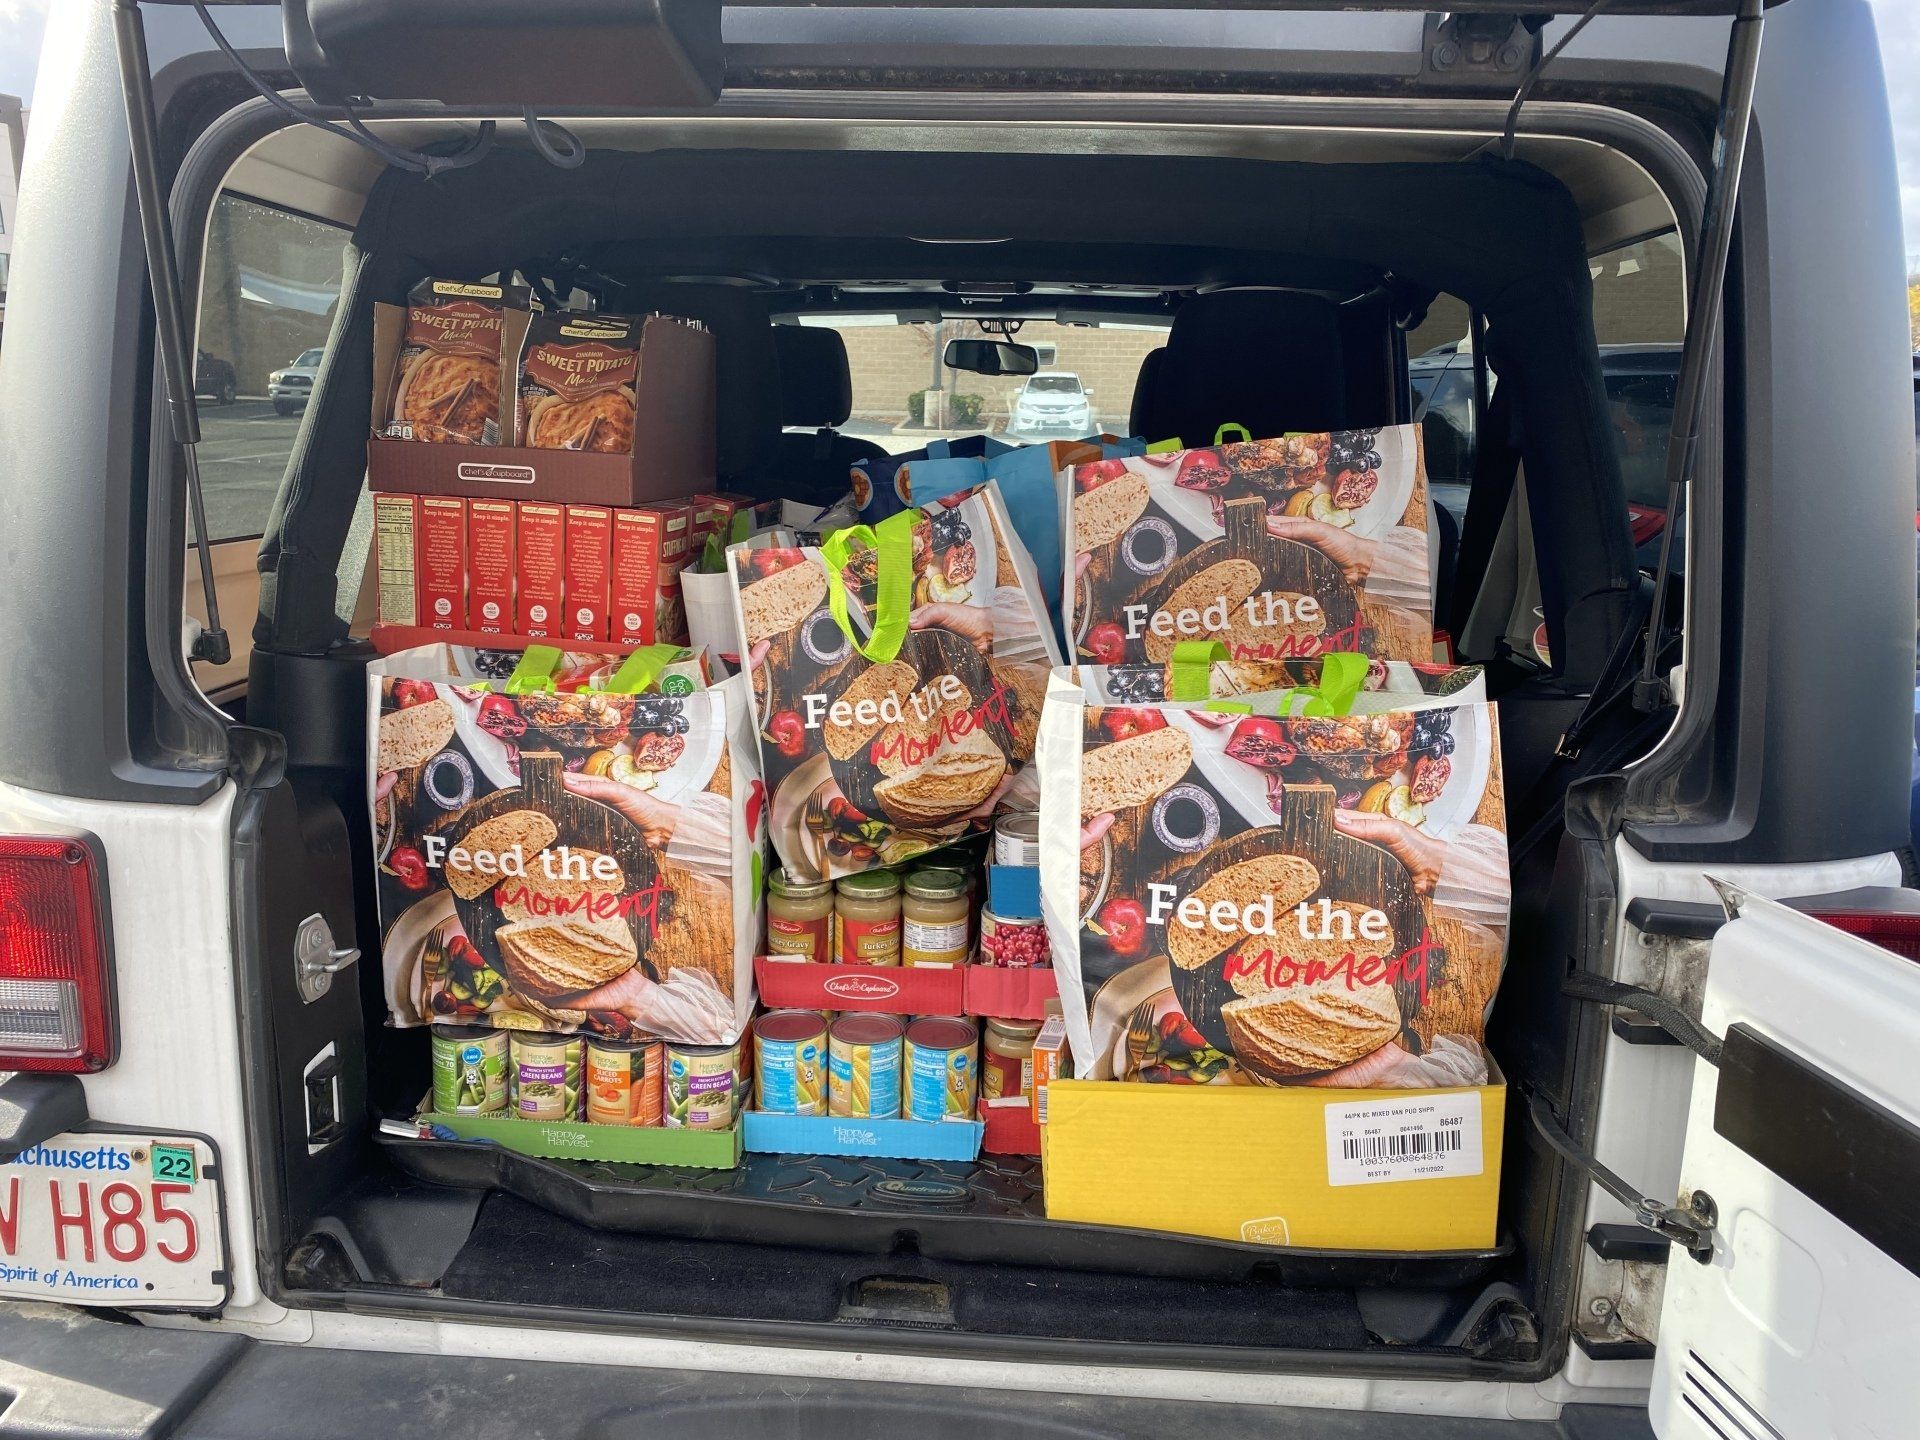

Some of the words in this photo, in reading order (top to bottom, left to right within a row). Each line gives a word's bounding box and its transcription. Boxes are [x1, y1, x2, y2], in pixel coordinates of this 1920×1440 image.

[412, 310, 460, 330] SWEET
[461, 318, 503, 330] POTAT
[438, 330, 473, 341] Mash
[537, 350, 585, 372] SWEET
[586, 355, 633, 372] POTATO
[564, 372, 598, 387] Mash
[464, 468, 485, 476] chef's
[492, 469, 529, 479] cupboard
[1123, 596, 1231, 640] Feed
[1243, 592, 1319, 627] the
[802, 690, 903, 729] Feed
[910, 675, 962, 721] the
[423, 835, 527, 877] Feed
[540, 846, 618, 880] the
[1146, 882, 1276, 936] Feed
[1295, 898, 1388, 941] the
[786, 940, 810, 949] Gravy
[863, 943, 888, 951] Turkey
[520, 1071, 540, 1080] GREEN
[540, 1071, 563, 1080] BEANS
[593, 1074, 623, 1083] CARROTS
[596, 1068, 617, 1077] SLICED
[712, 1078, 731, 1089] BEANS
[1391, 1108, 1403, 1116] VAN
[1439, 1117, 1463, 1127] 86487
[541, 1127, 577, 1140] Happy
[833, 1126, 866, 1138] Happy
[548, 1136, 590, 1148] Harvest
[838, 1135, 877, 1146] Harvest
[1359, 1152, 1446, 1166] 10037600864876
[159, 1155, 191, 1179] 22
[1413, 1165, 1444, 1174] 11/21/2022
[49, 1180, 198, 1263] H85
[0, 1262, 38, 1283] Spirit
[43, 1269, 60, 1288] of
[62, 1270, 139, 1289] America
